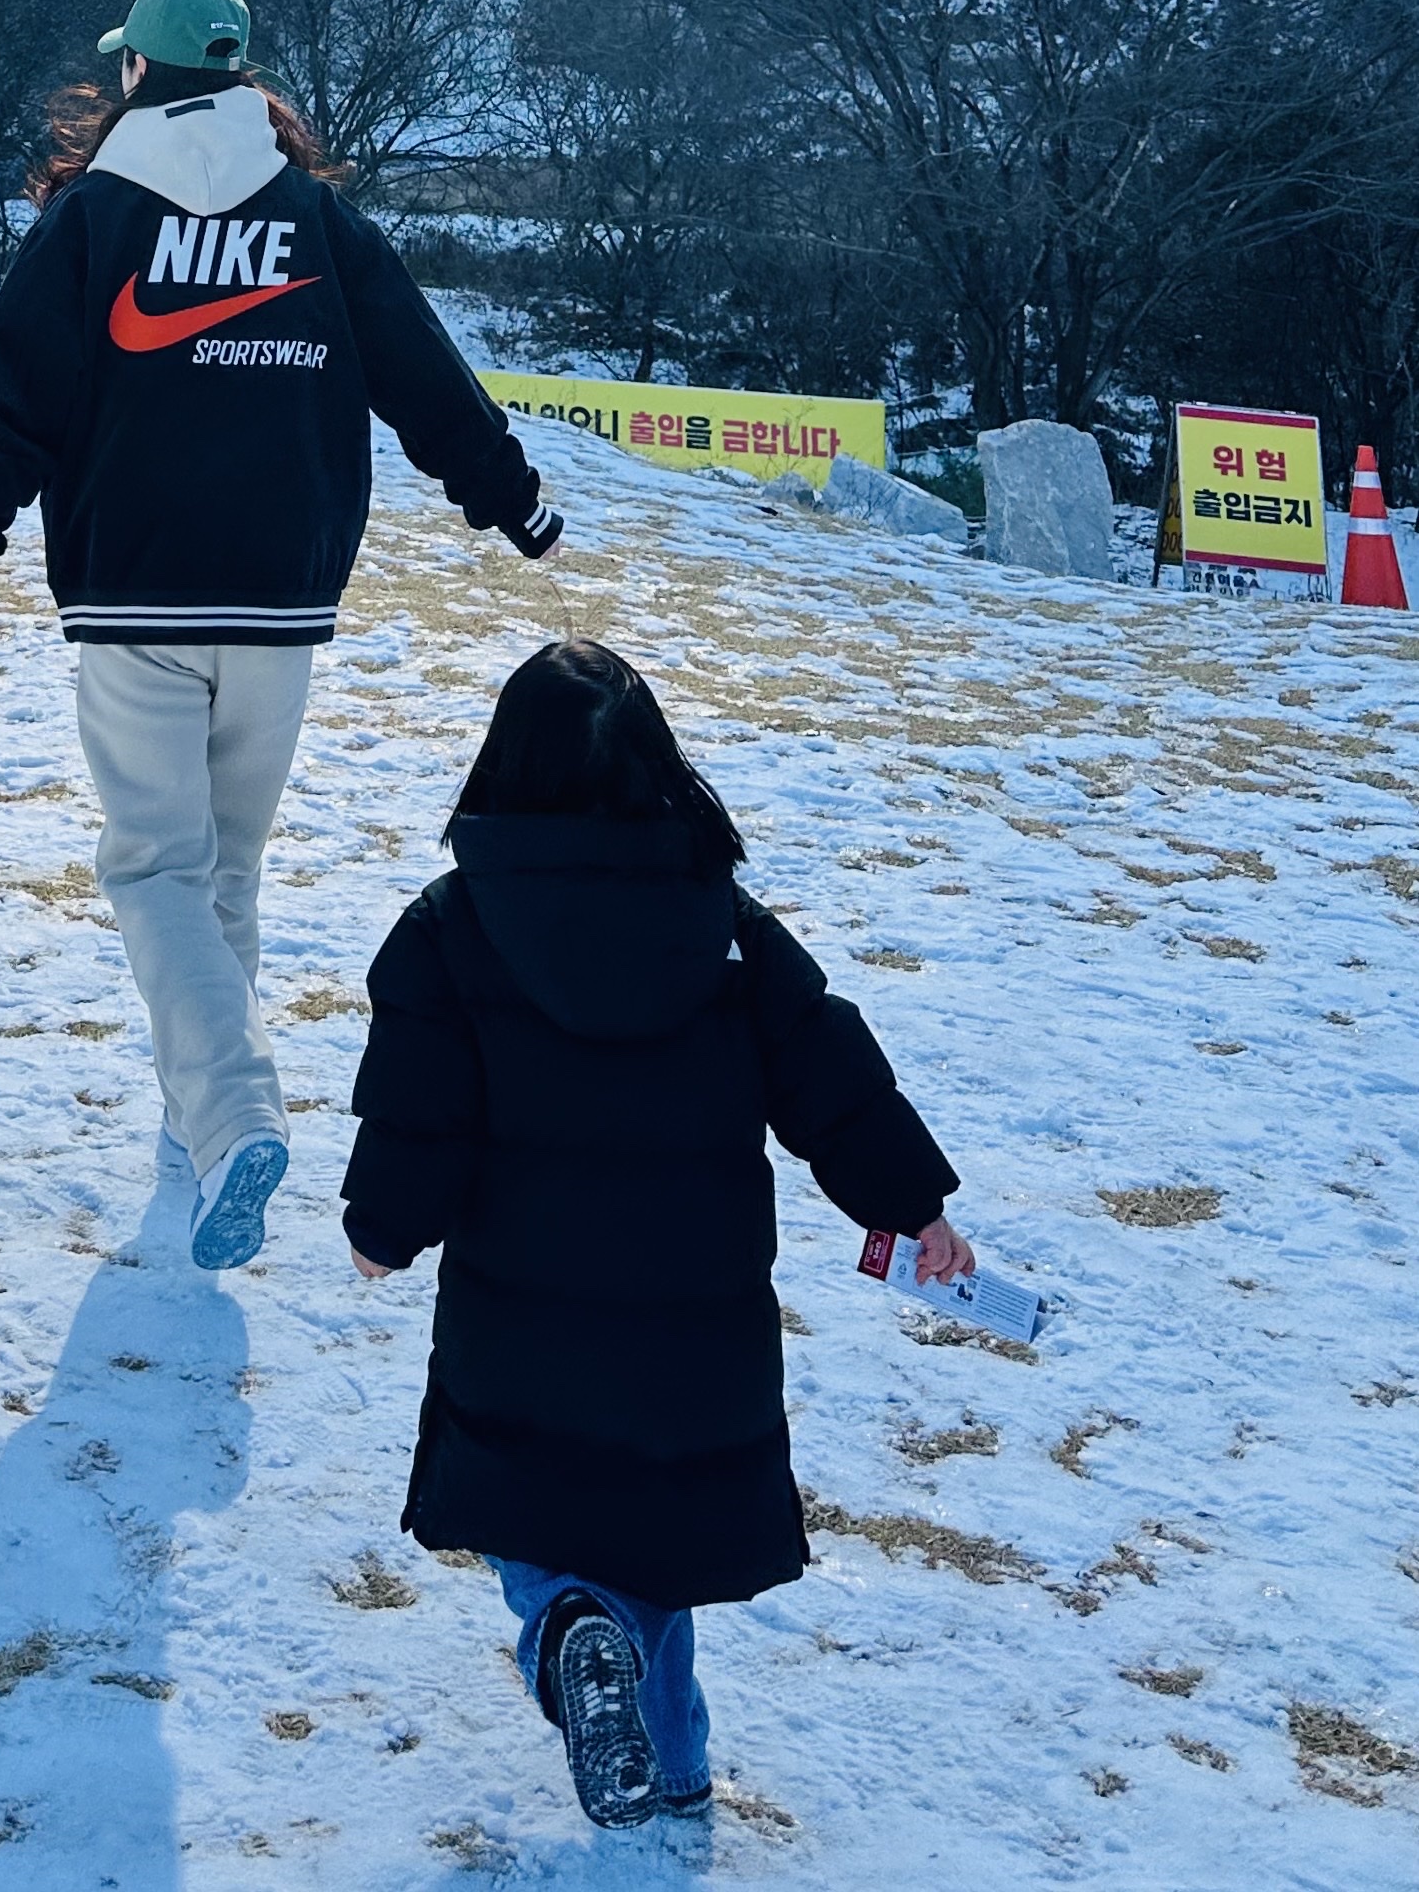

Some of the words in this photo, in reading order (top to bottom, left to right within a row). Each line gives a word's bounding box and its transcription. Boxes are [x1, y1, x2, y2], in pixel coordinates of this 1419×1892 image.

[147, 215, 296, 286] NIKE
[192, 338, 328, 369] SPORTSWEAR
[629, 411, 712, 450] 출입을
[722, 419, 841, 460] 금합니다
[1193, 488, 1313, 528] 출입금지
